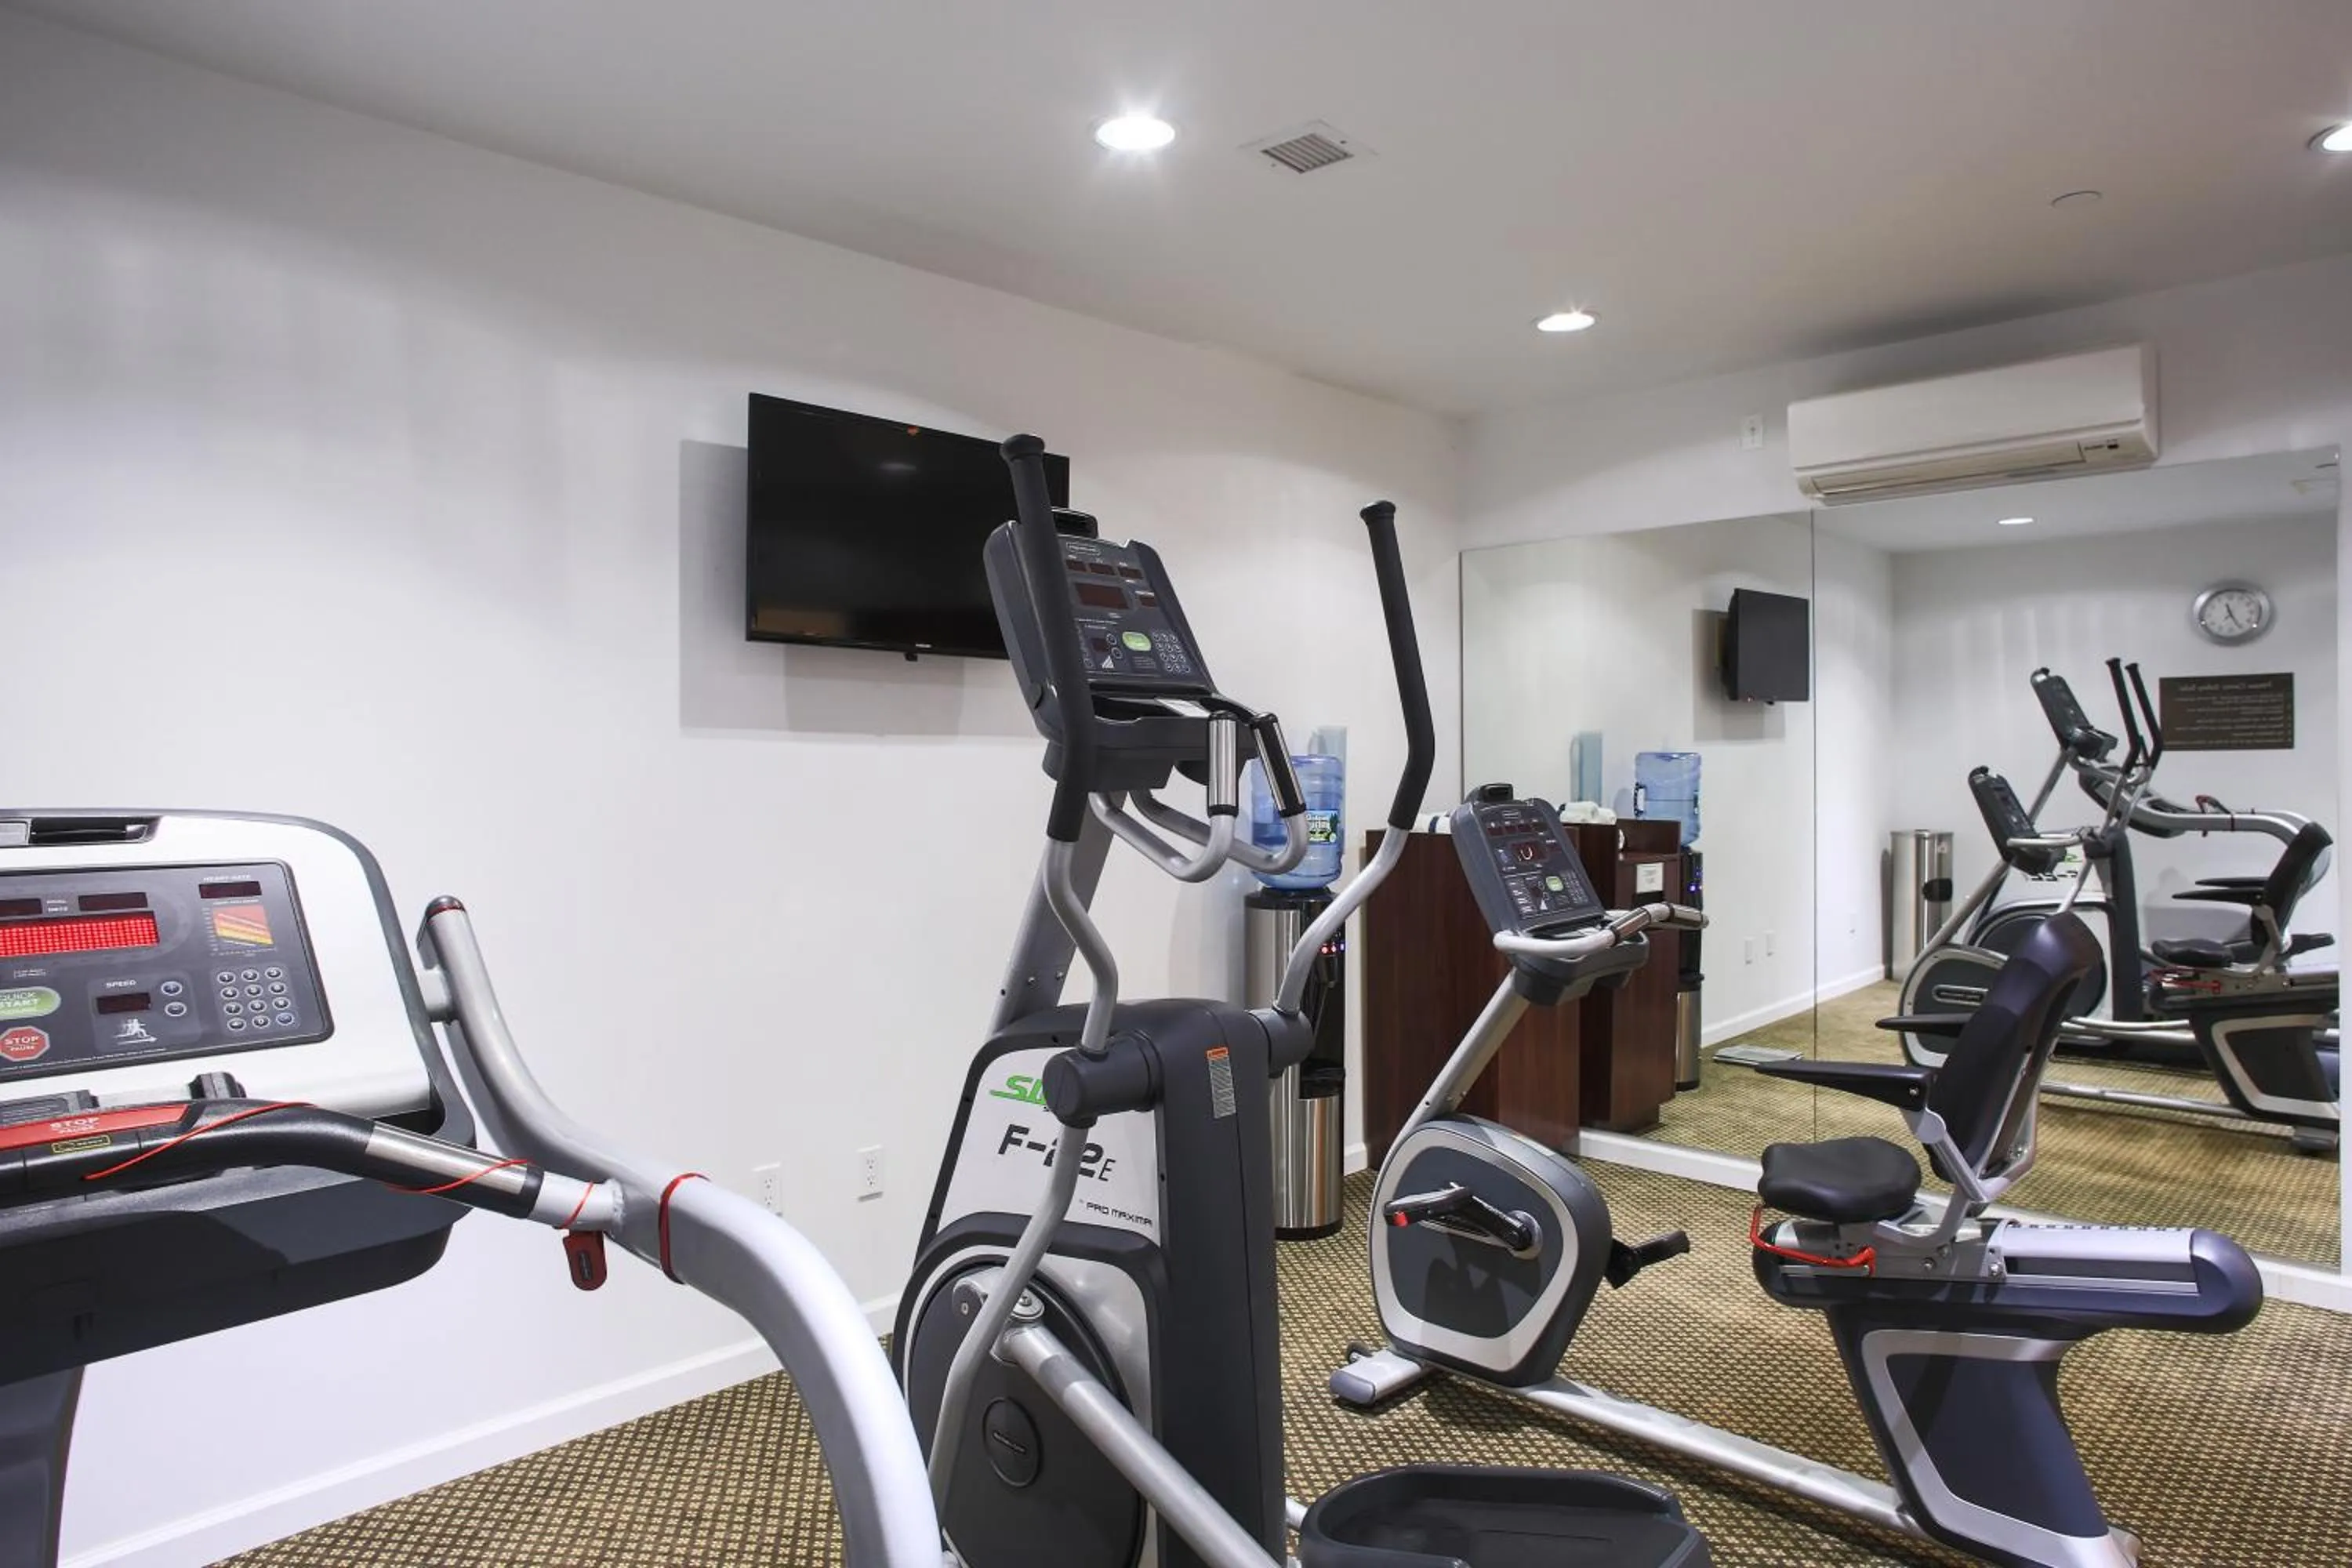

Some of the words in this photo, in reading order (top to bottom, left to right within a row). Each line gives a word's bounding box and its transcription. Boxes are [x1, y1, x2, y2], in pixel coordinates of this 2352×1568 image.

[106, 979, 137, 989] SPEED
[4, 1036, 40, 1045] STOP
[50, 1117, 100, 1130] STOP
[1086, 1202, 1109, 1215] PRO
